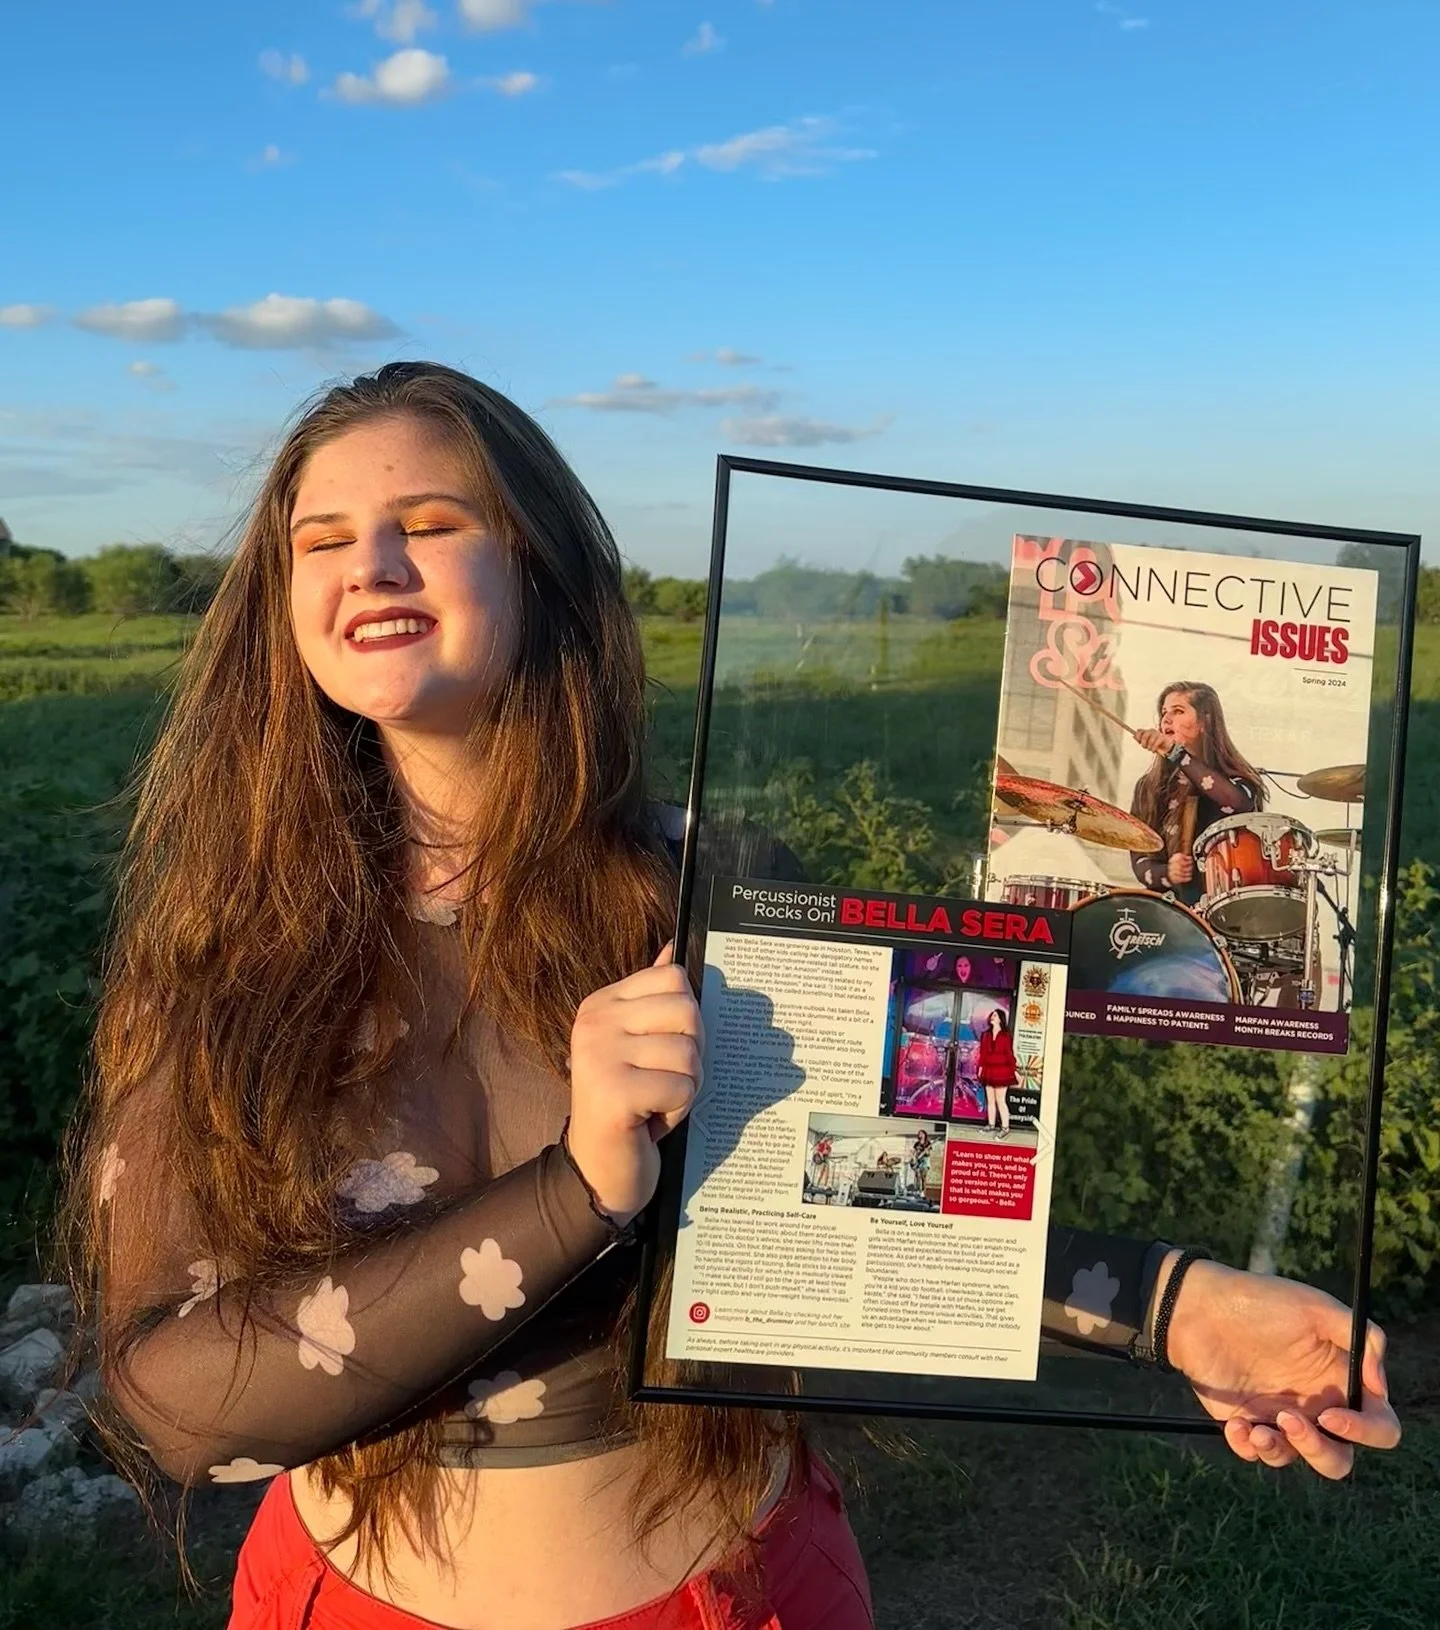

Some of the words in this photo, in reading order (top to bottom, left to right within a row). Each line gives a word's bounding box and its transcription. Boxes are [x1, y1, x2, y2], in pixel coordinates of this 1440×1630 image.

[1036, 557, 1353, 622] CONNECTIVE
[1250, 618, 1349, 664] ISSUES
[1302, 677, 1326, 686] Spring
[1328, 679, 1346, 687] 2024
[732, 885, 836, 907] Percussionist
[840, 897, 952, 934] BELLA
[960, 909, 1055, 944] SERA
[754, 903, 802, 921] Rocks
[806, 906, 835, 923] On!
[1106, 1004, 1137, 1014] FAMILY
[1138, 1007, 1174, 1018] SPREADS
[1175, 1010, 1225, 1022] AWARENESS
[1113, 1015, 1157, 1026] HAPPINESS
[1158, 1018, 1170, 1027] TO
[1170, 1020, 1209, 1030] PATIENTS
[1235, 1016, 1269, 1026] MARFAN
[1270, 1020, 1319, 1030] AWARENESS
[1234, 1026, 1265, 1035] MONTH
[1265, 1027, 1296, 1038] BREAKS
[1297, 1031, 1334, 1040] RECORDS
[1009, 1095, 1021, 1104] The
[1021, 1096, 1038, 1105] Pride
[989, 1171, 1012, 1179] There's
[1013, 1174, 1028, 1182] only
[998, 1182, 1011, 1190] you,
[988, 1189, 1010, 1197] makes
[958, 1197, 994, 1205] gorgeous."
[699, 1206, 719, 1214] Being
[720, 1207, 750, 1215] Realistic,
[751, 1209, 785, 1219] Practicing
[880, 1218, 908, 1226] Yourself,
